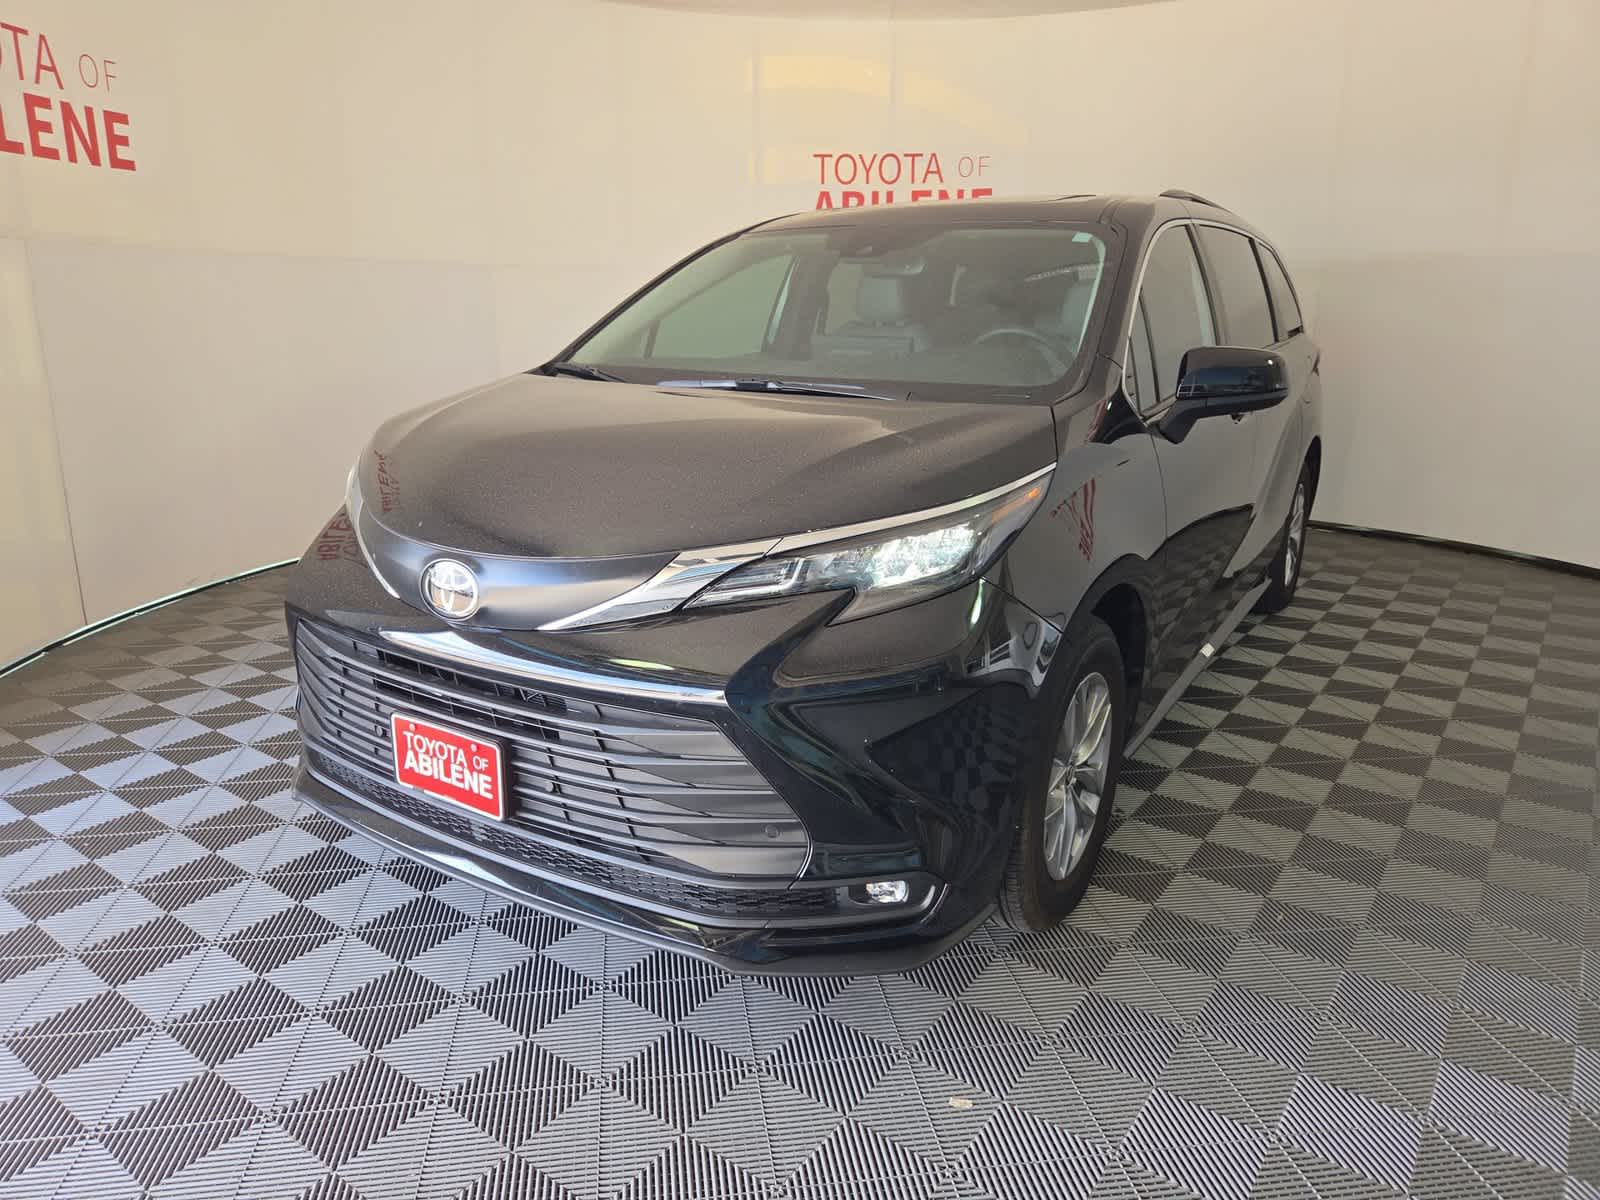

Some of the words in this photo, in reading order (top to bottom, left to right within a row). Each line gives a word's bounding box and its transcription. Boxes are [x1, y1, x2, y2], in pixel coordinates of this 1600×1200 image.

[78, 53, 117, 92] OF
[812, 152, 944, 185] TOYOTA
[957, 155, 991, 178] OF
[402, 730, 468, 768] TOYOTA
[472, 754, 489, 772] OF
[403, 750, 494, 800] ABILENE
